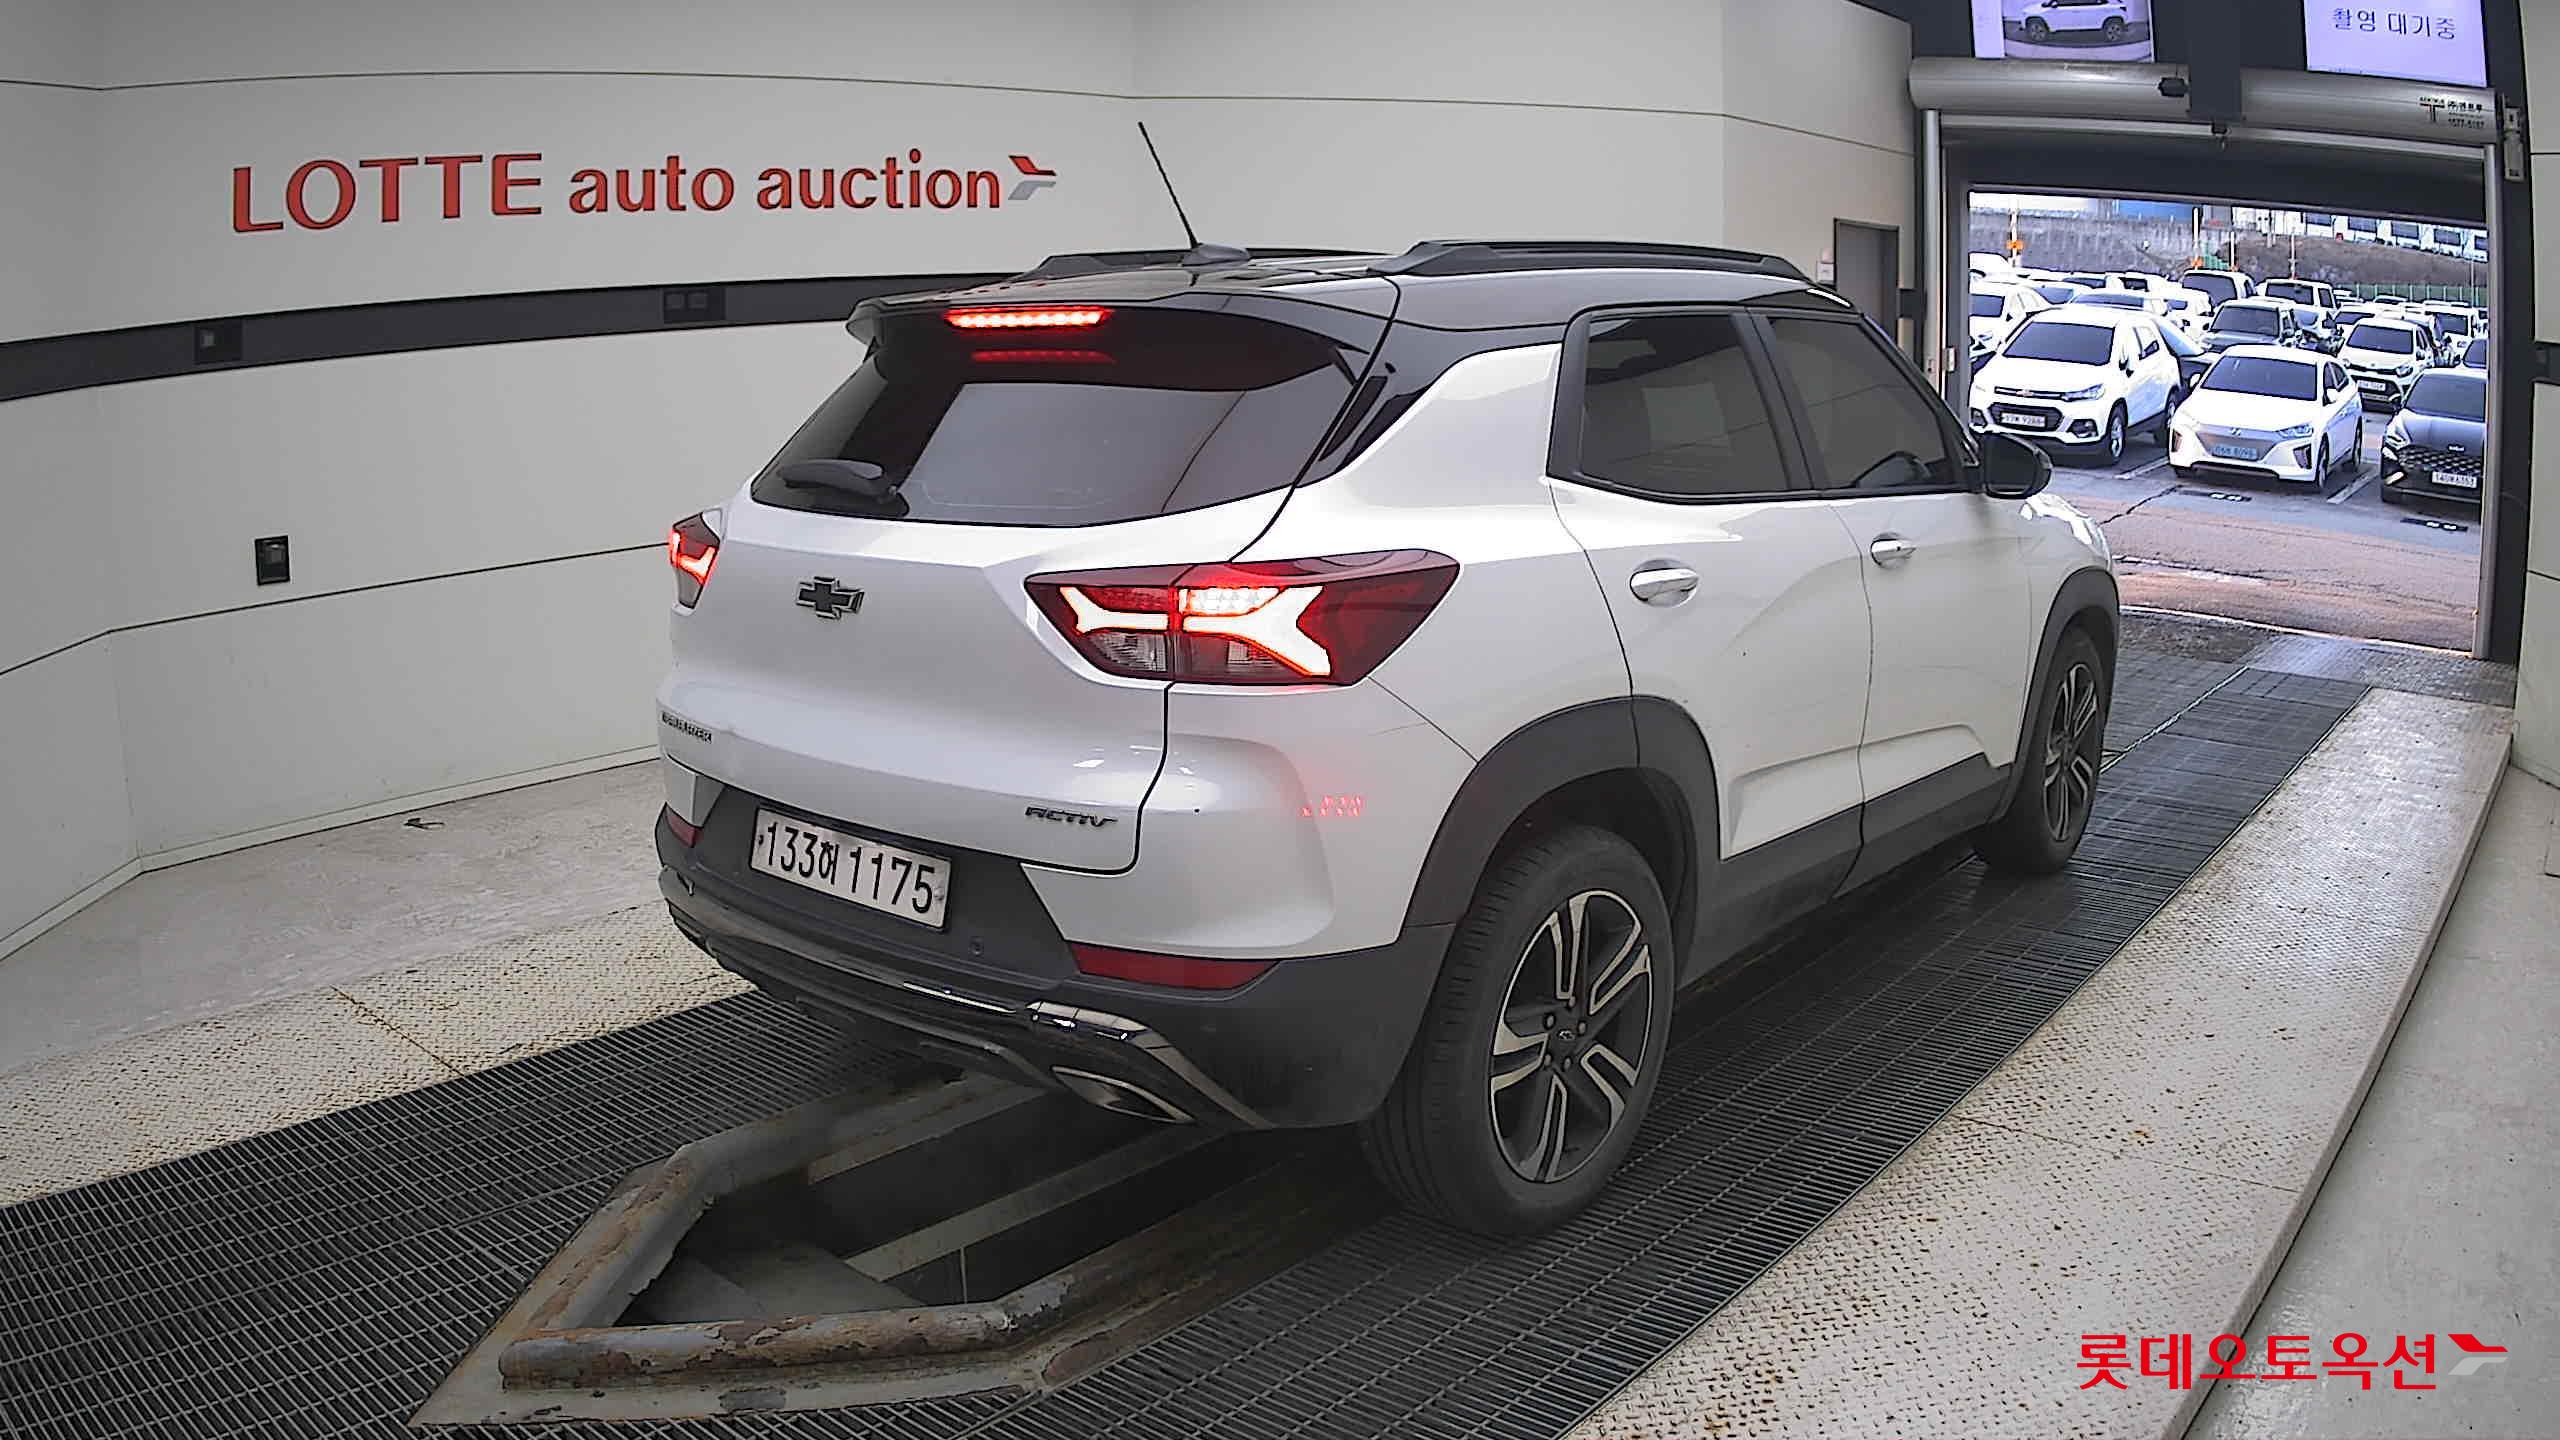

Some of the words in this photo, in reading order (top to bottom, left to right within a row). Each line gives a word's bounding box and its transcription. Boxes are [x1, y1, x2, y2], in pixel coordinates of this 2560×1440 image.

[2332, 7, 2376, 33] 촬영
[2387, 12, 2456, 40] 대기중
[232, 152, 543, 233] LOTTE
[568, 155, 734, 213] auto
[757, 148, 1001, 210] auction
[1025, 806, 1118, 828] ACTIV
[766, 820, 839, 886] 133허
[848, 845, 936, 914] 1175
